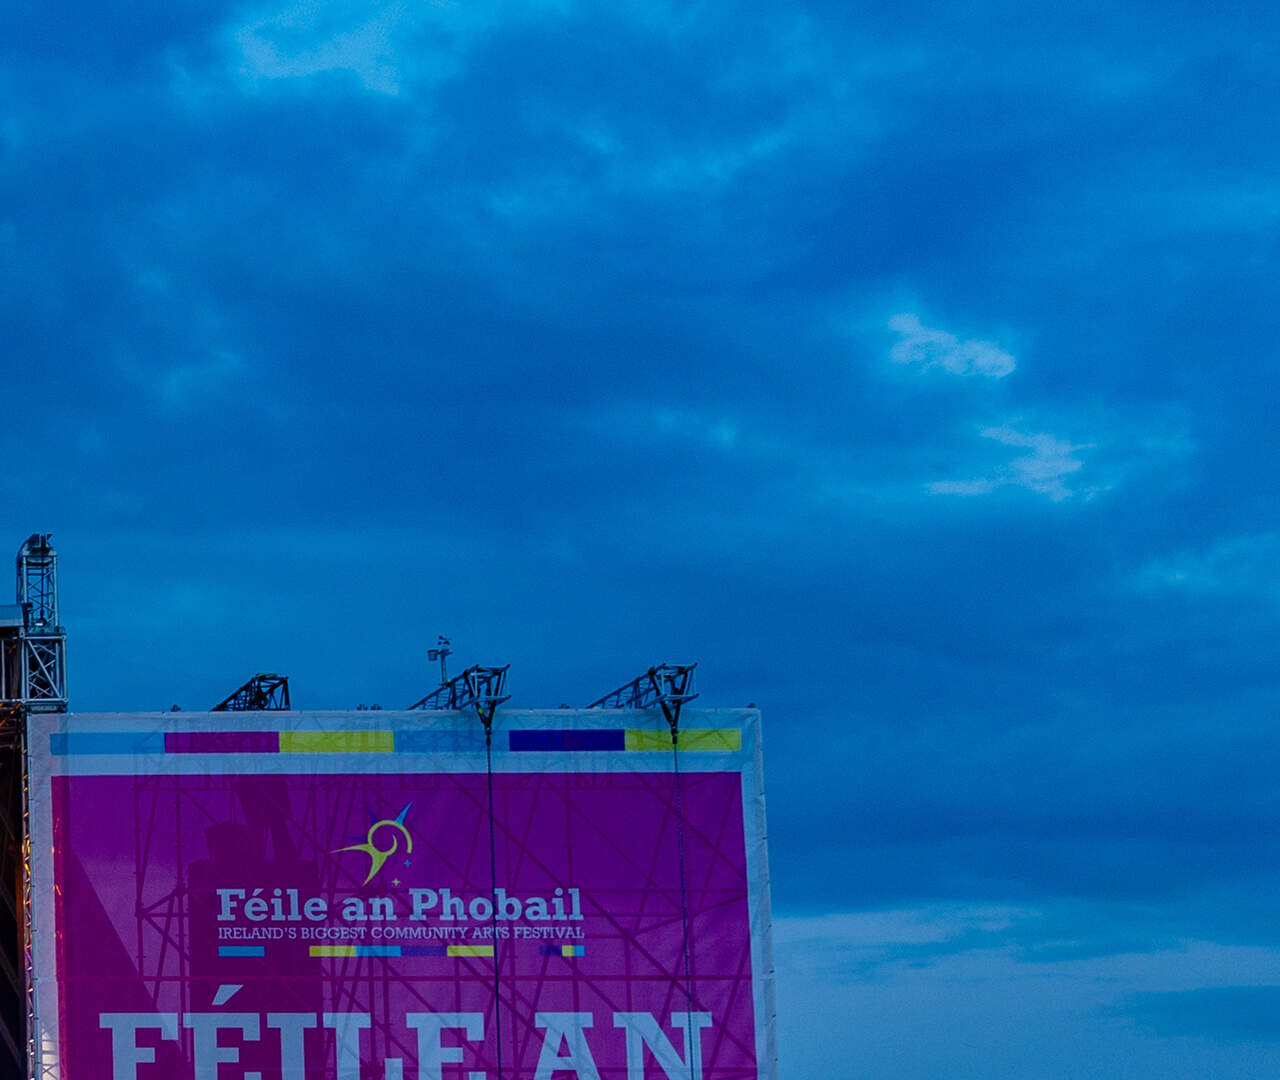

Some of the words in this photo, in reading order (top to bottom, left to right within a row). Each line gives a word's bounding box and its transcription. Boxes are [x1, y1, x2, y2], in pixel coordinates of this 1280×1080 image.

[216, 888, 328, 921] Féile
[342, 898, 397, 921] an
[408, 888, 584, 921] Phobail
[218, 926, 297, 940] IRELAND'S
[301, 926, 366, 940] BIGGEST
[370, 926, 468, 940] COMMUNITY
[471, 926, 510, 940] ARTS
[513, 926, 585, 940] FESTIVAL
